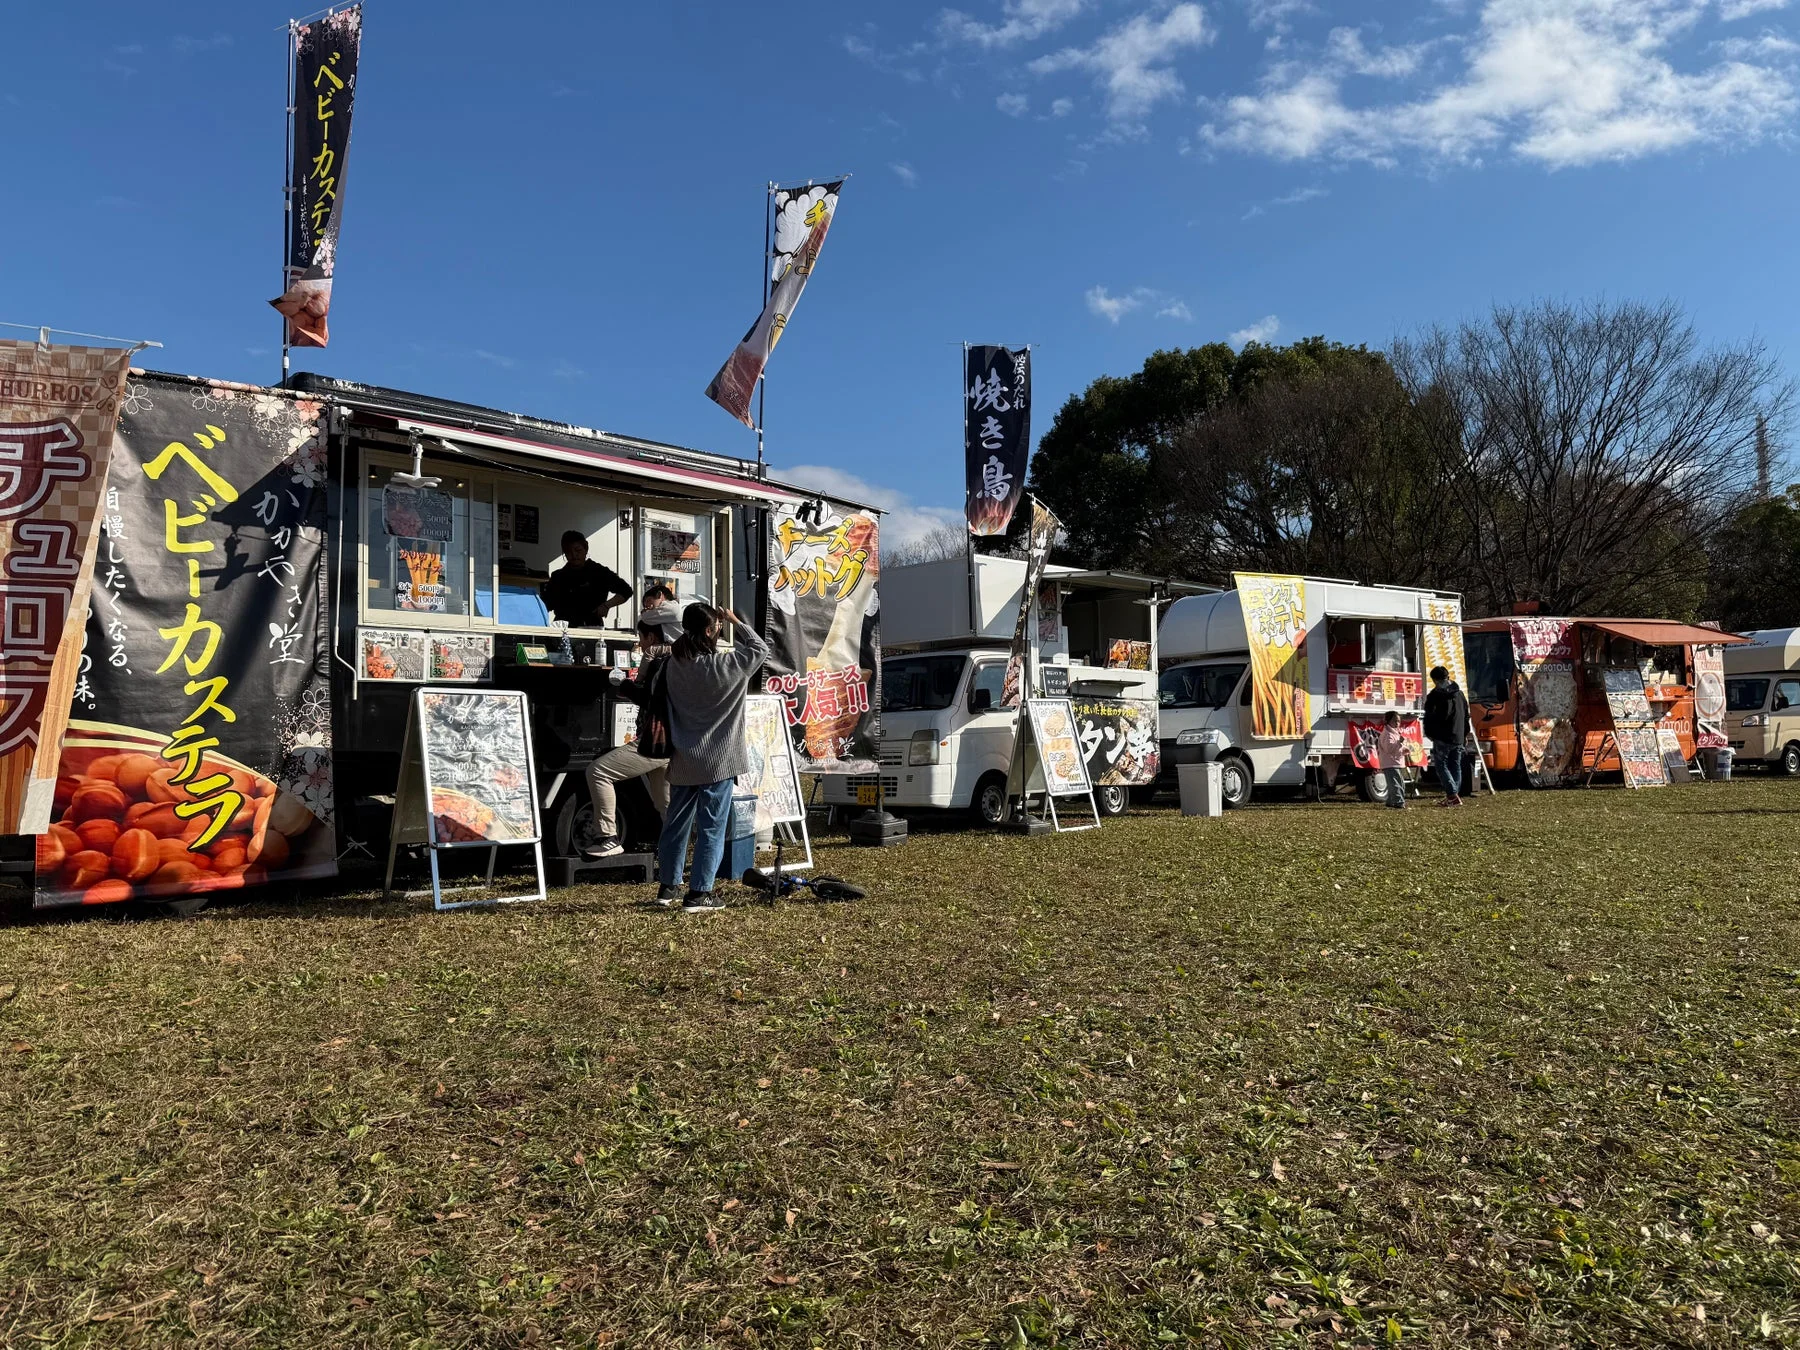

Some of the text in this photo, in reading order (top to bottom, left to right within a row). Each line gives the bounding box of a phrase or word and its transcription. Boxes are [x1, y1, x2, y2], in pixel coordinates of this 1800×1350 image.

[1013, 354, 1026, 410] 秘伝のたれ
[970, 367, 1013, 502] 焼き鳥
[776, 518, 853, 557] チーズ
[101, 487, 133, 675] 自慢したくなる、
[251, 489, 306, 665] かがやき堂
[675, 560, 700, 572] 500円
[774, 550, 868, 601] ハットグ
[141, 424, 244, 850] ベビーカステラ
[1259, 601, 1305, 635] ポテト
[767, 662, 861, 693] のびーるチーズ
[1658, 720, 1690, 734] ROTOLO
